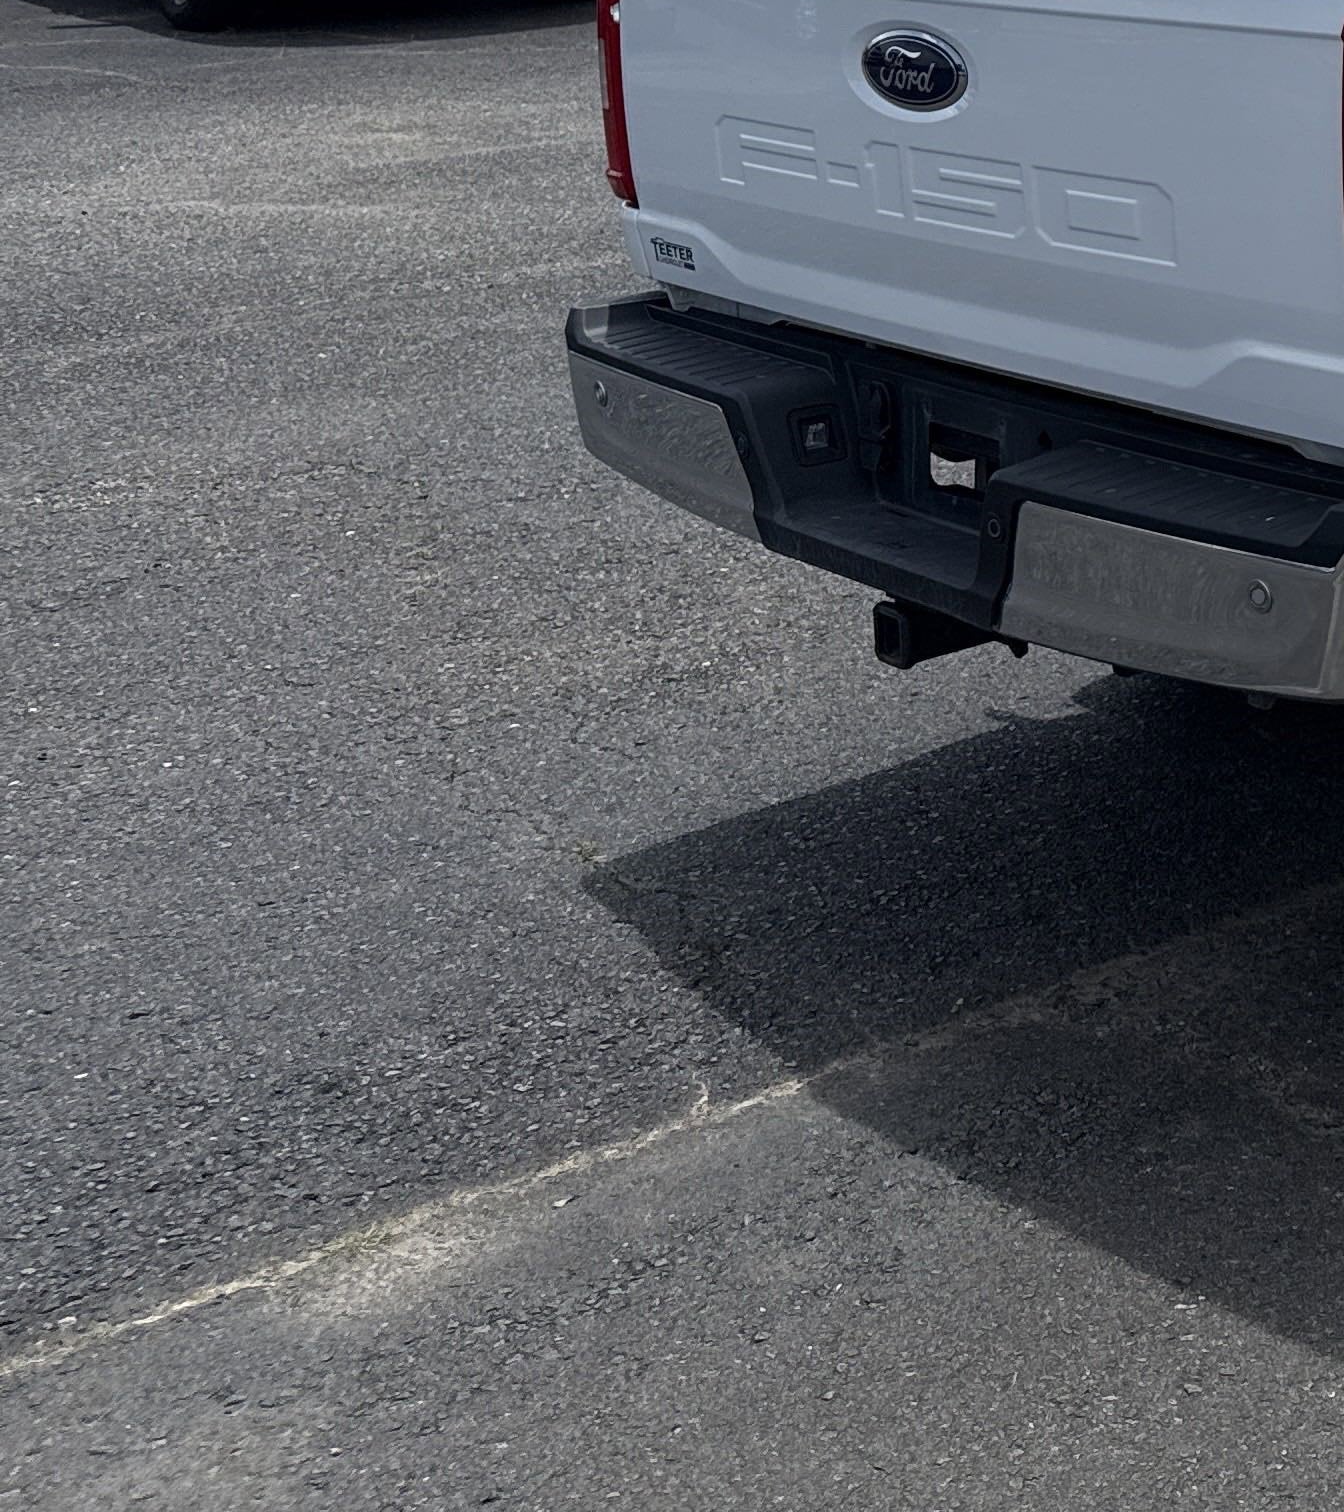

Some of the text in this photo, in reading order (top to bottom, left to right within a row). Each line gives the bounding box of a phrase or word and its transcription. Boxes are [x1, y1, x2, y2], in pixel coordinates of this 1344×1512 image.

[880, 45, 937, 94] Ford
[714, 114, 1177, 267] F-150
[650, 237, 695, 263] TEETER
